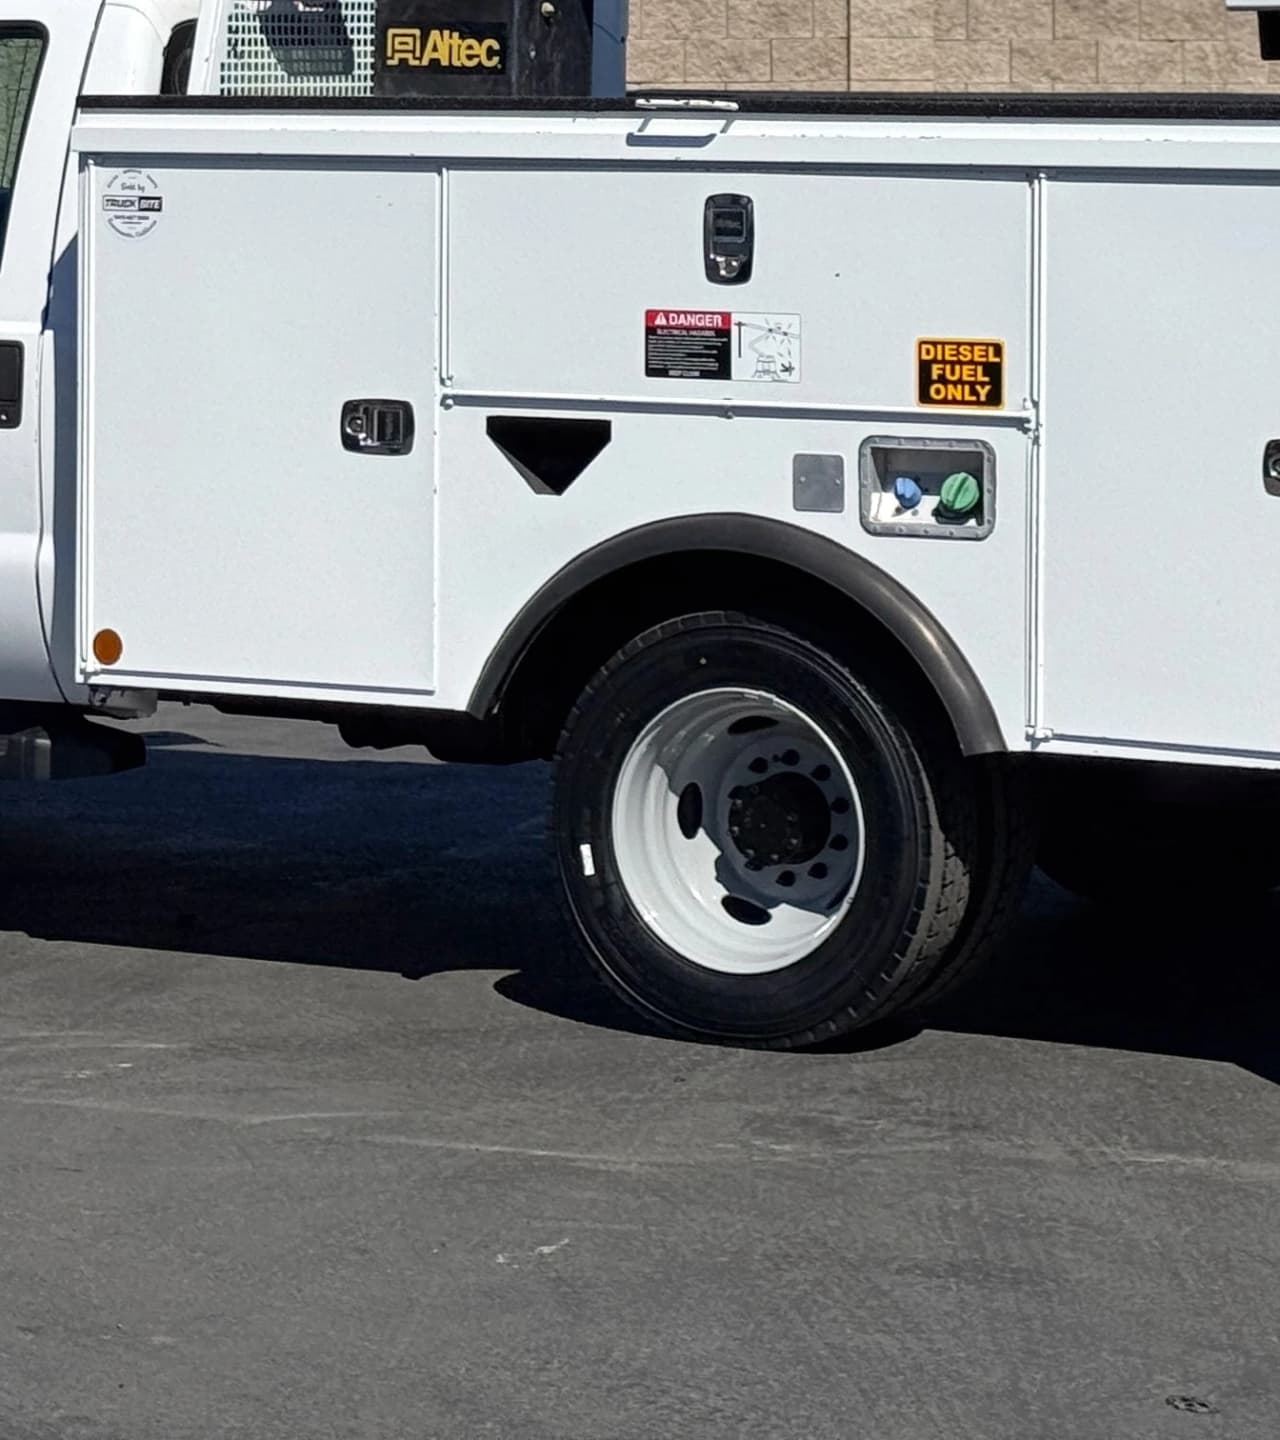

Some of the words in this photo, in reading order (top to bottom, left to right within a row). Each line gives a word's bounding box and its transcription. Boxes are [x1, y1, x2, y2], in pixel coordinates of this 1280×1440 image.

[420, 29, 500, 68] Altec
[105, 198, 137, 208] TRUCK
[668, 312, 722, 328] DANGER
[921, 344, 1000, 362] DIESEL
[931, 364, 990, 382] FUEL
[929, 384, 991, 401] ONLY
